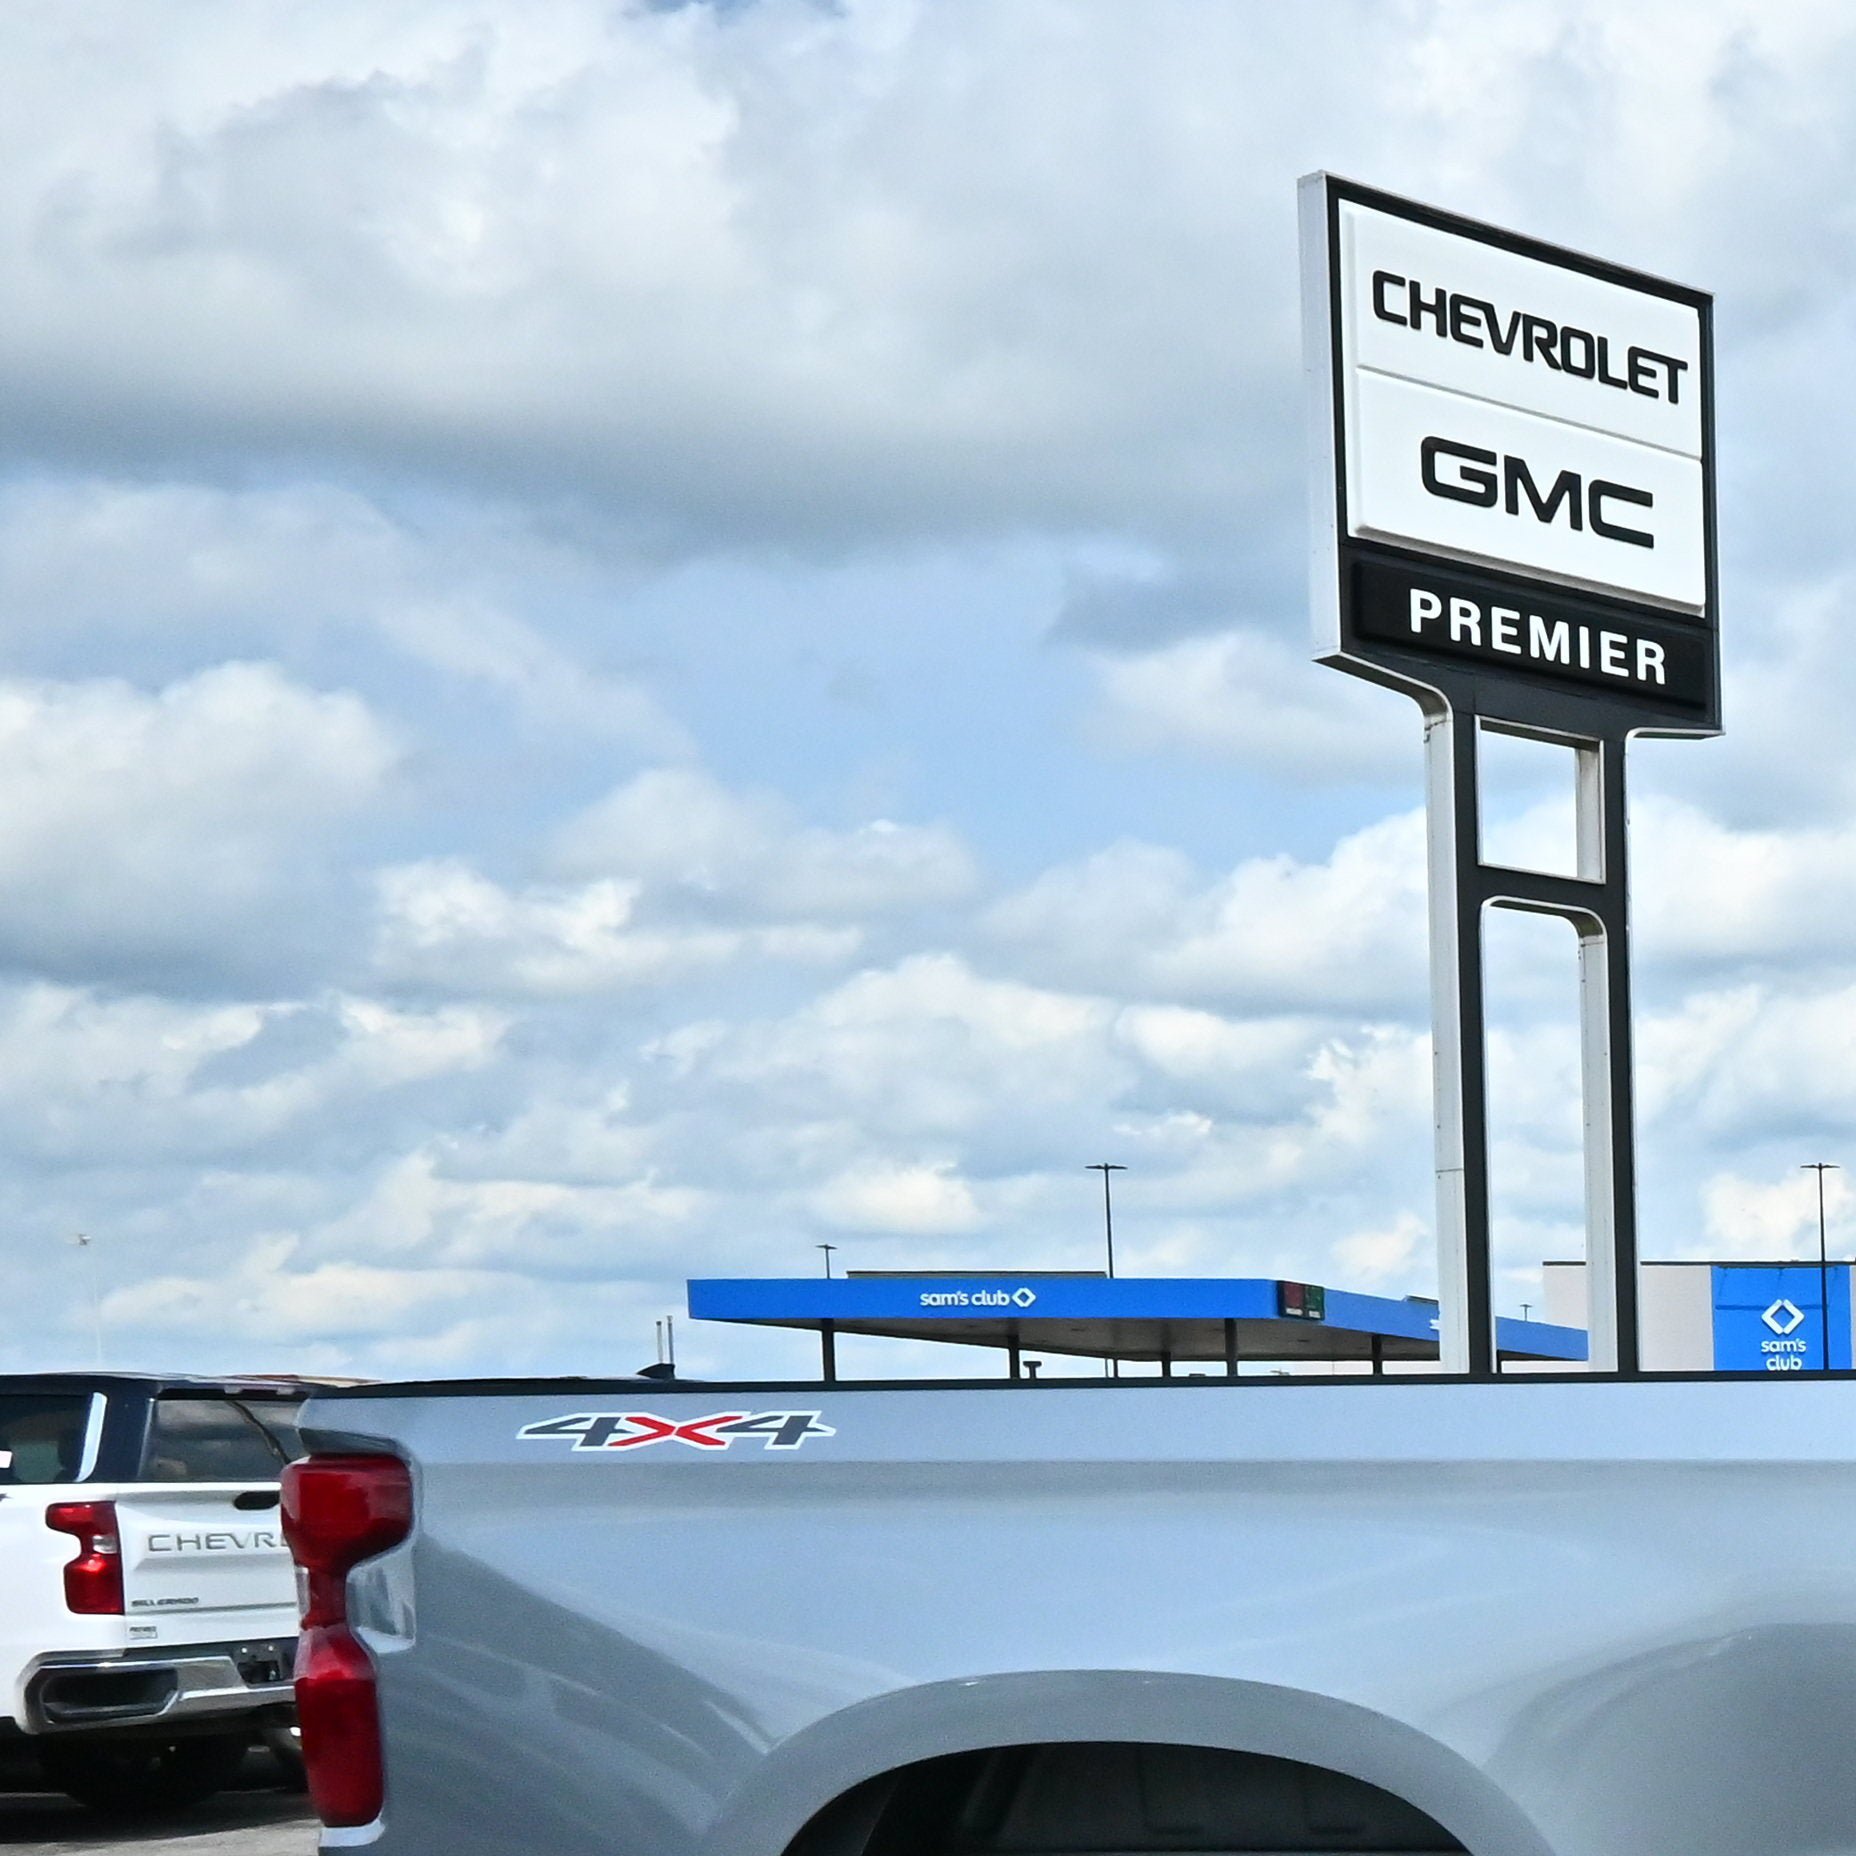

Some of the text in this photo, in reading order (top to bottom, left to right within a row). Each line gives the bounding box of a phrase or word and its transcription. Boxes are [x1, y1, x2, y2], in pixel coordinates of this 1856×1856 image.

[1372, 270, 1688, 405] CHEVROLET
[1421, 436, 1655, 549] GMC
[1410, 588, 1666, 685] PREMIER
[919, 1289, 1010, 1306] sam's club
[1761, 1338, 1807, 1353] sam's
[1766, 1354, 1802, 1371] club
[148, 1532, 288, 1552] CHEVR
